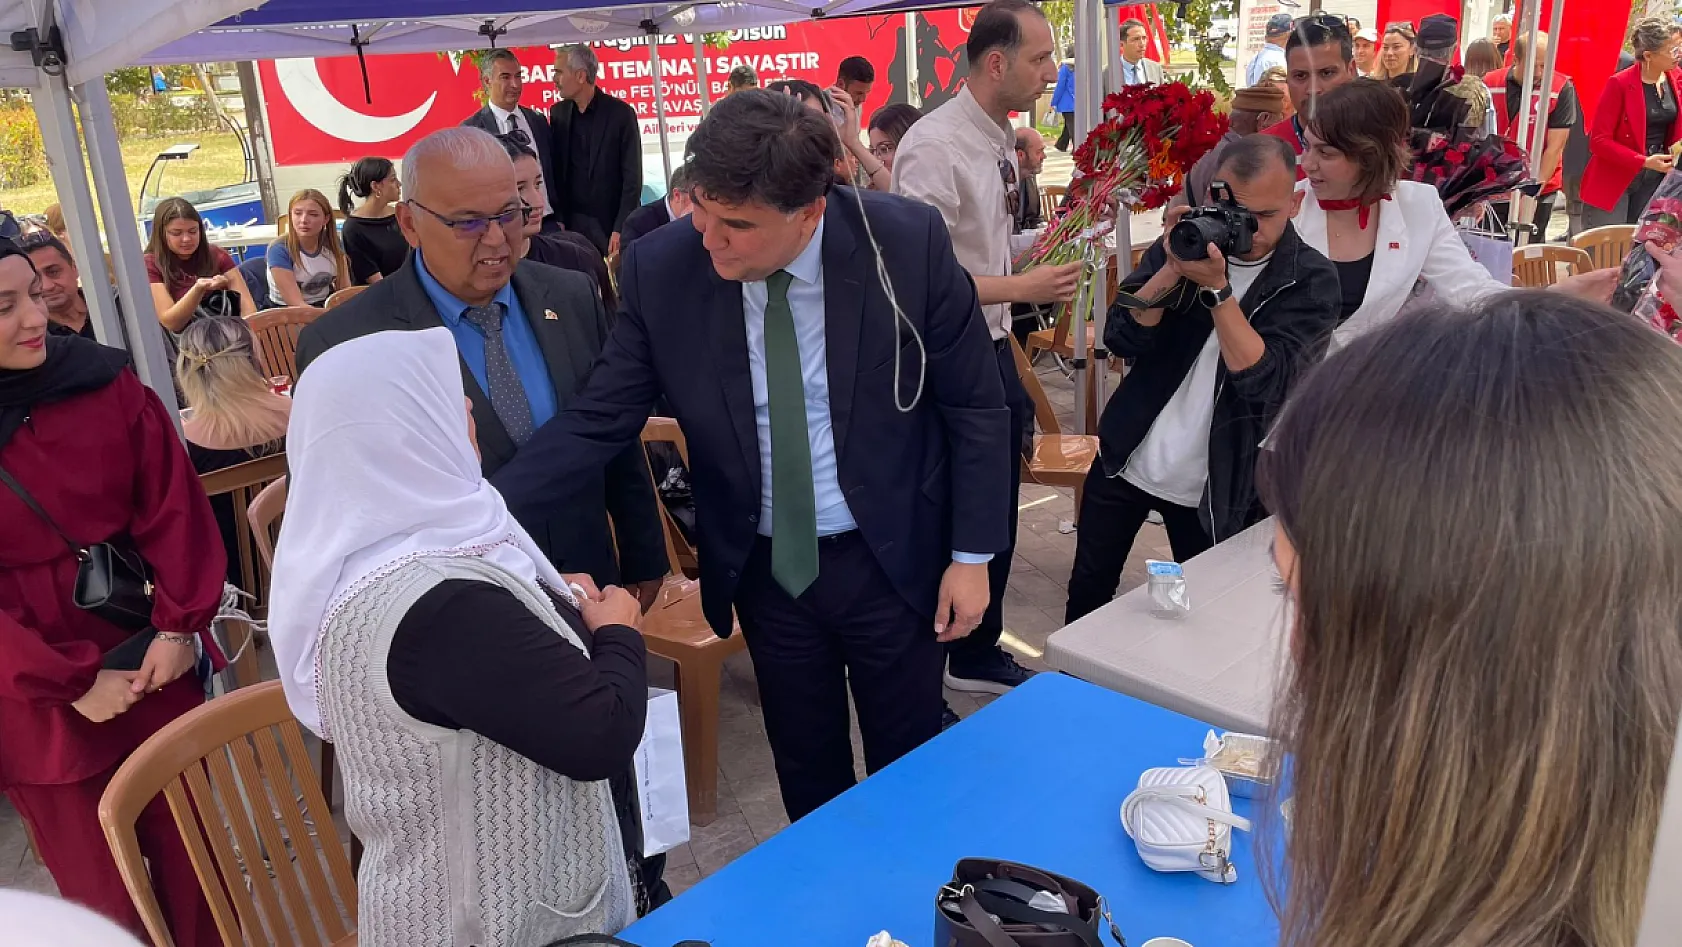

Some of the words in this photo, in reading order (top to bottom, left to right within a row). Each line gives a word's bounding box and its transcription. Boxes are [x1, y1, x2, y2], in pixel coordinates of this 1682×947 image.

[608, 55, 712, 78] TEMİNAI
[716, 52, 819, 74] SAVAŞTIR
[610, 87, 627, 99] ve
